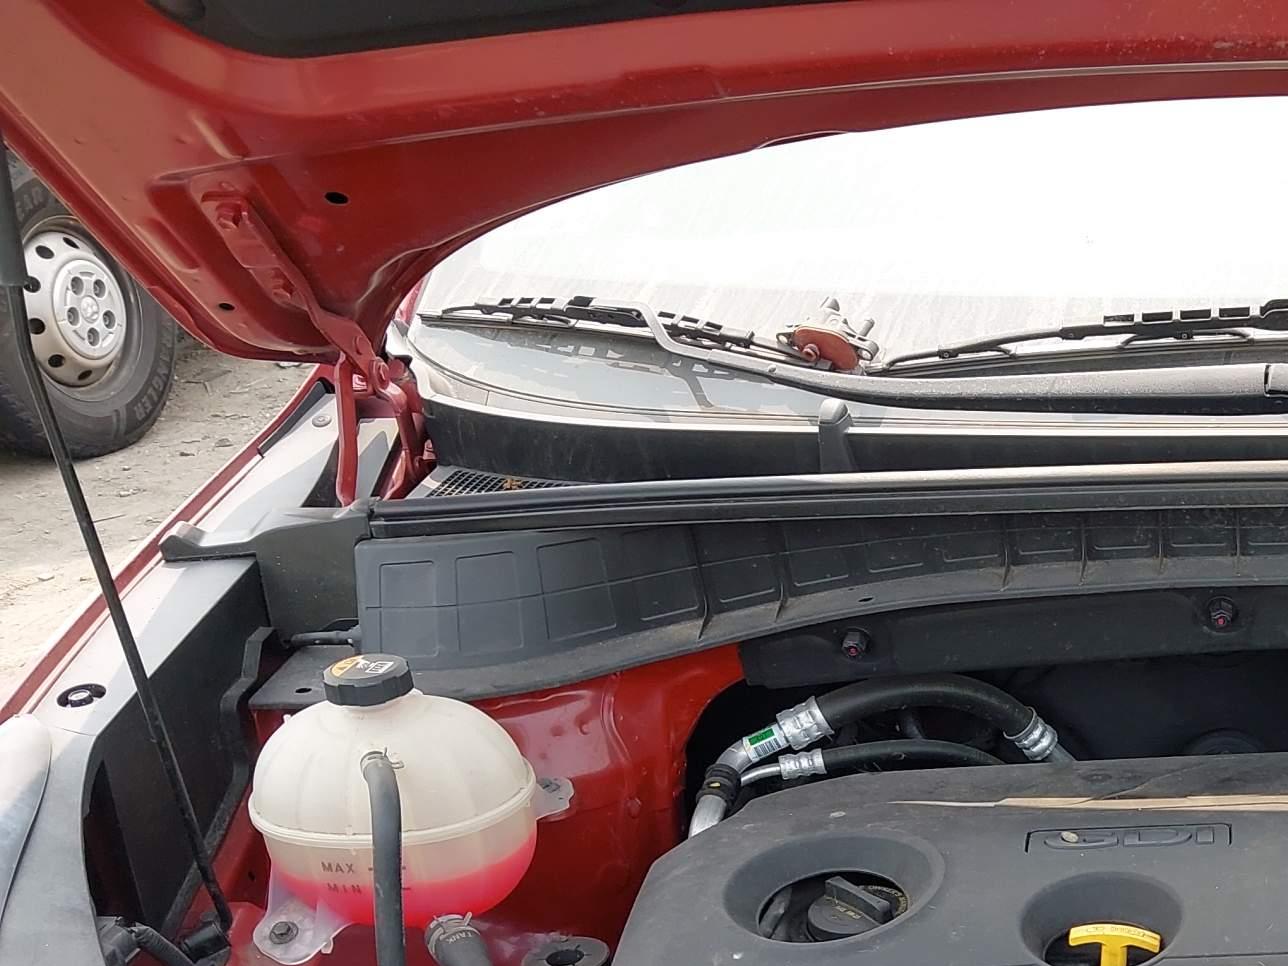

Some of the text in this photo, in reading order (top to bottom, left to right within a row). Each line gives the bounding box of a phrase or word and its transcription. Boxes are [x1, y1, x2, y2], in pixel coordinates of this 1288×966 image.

[1043, 827, 1215, 850] GDI
[321, 862, 355, 874] MAX
[327, 883, 362, 894] MIN
